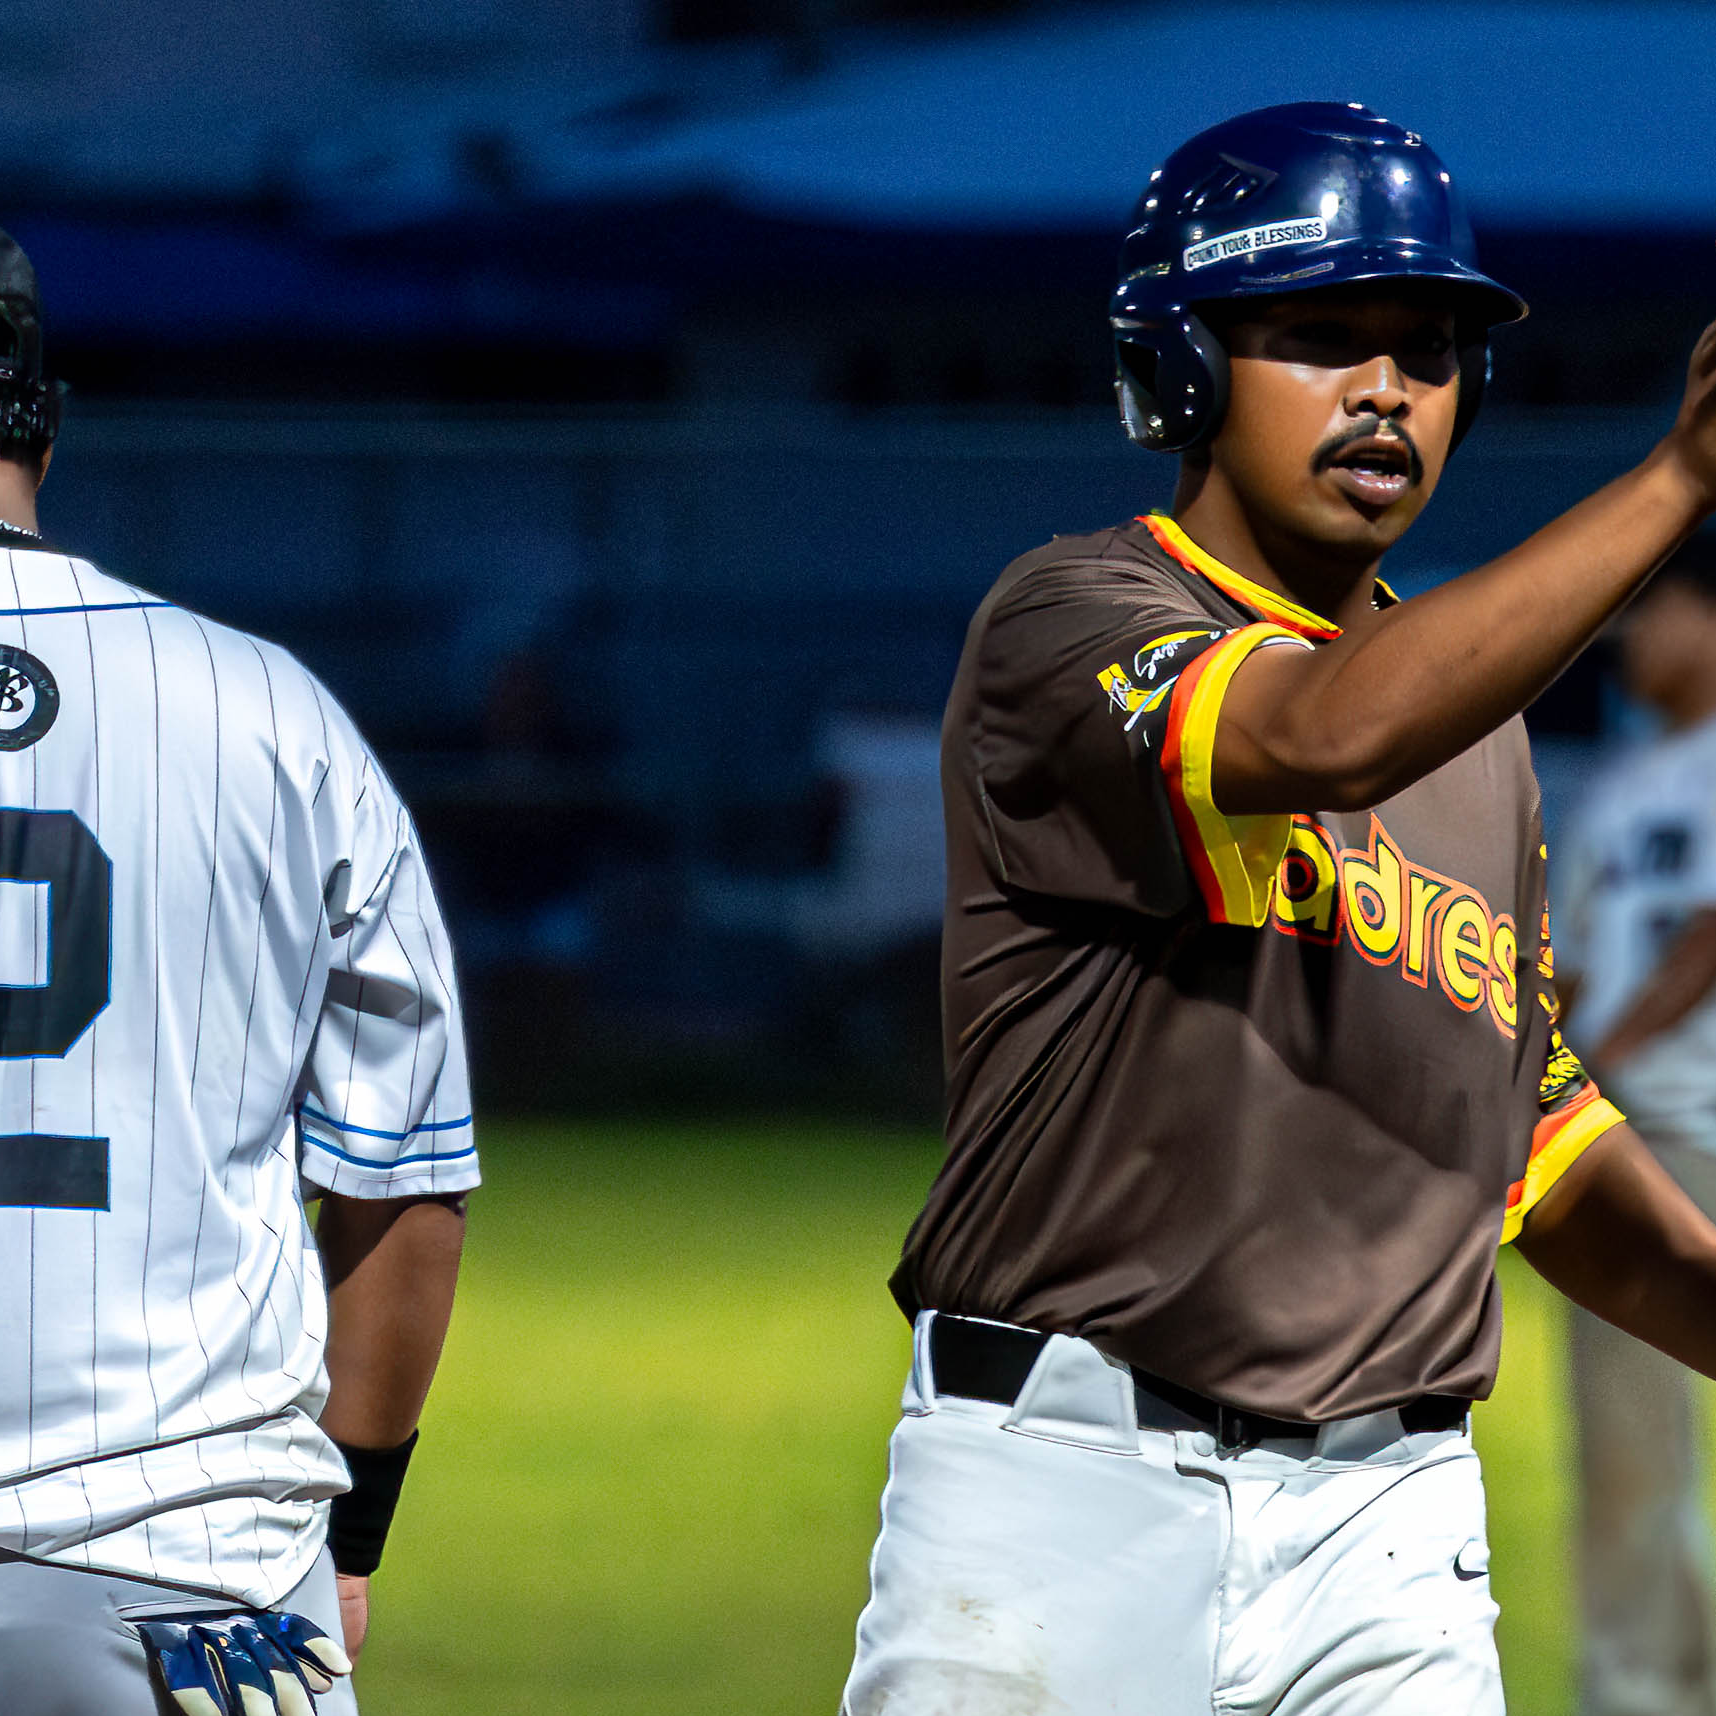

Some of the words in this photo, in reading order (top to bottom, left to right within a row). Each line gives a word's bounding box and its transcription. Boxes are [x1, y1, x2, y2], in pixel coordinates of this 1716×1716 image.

[1220, 234, 1251, 255] YOUR
[1254, 223, 1323, 247] BLESSINGS
[1271, 811, 1518, 1040] adres
